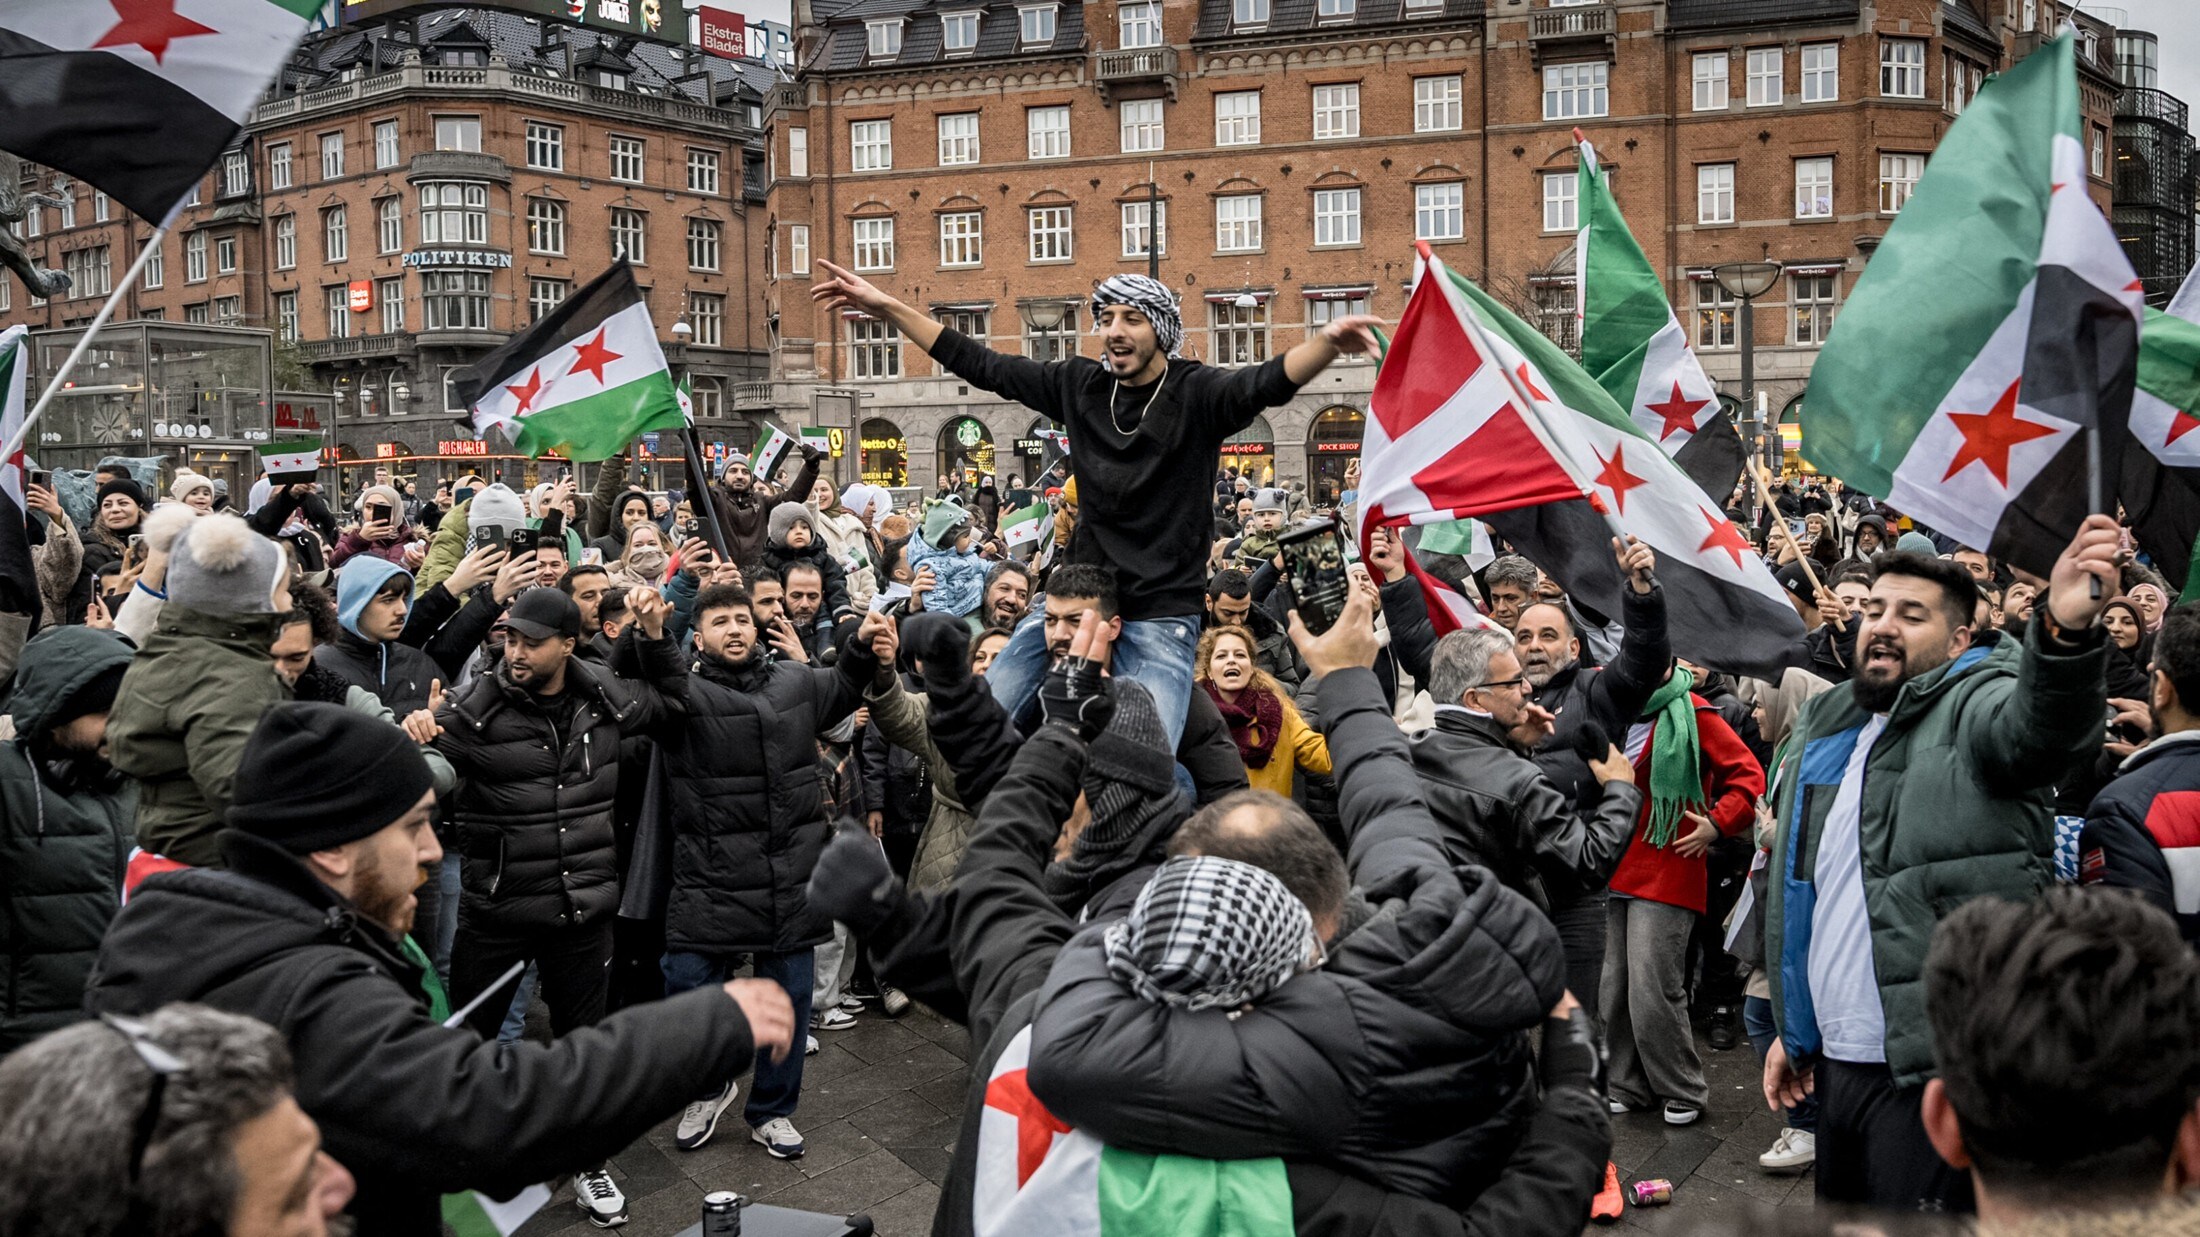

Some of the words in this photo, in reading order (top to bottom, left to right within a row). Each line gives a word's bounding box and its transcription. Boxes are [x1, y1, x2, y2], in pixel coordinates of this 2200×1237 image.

[704, 23, 743, 43] Ekstra
[704, 36, 743, 55] Bladet
[401, 251, 513, 268] POLITIKEN
[860, 439, 887, 449] Netto
[1249, 444, 1264, 452] Cafe
